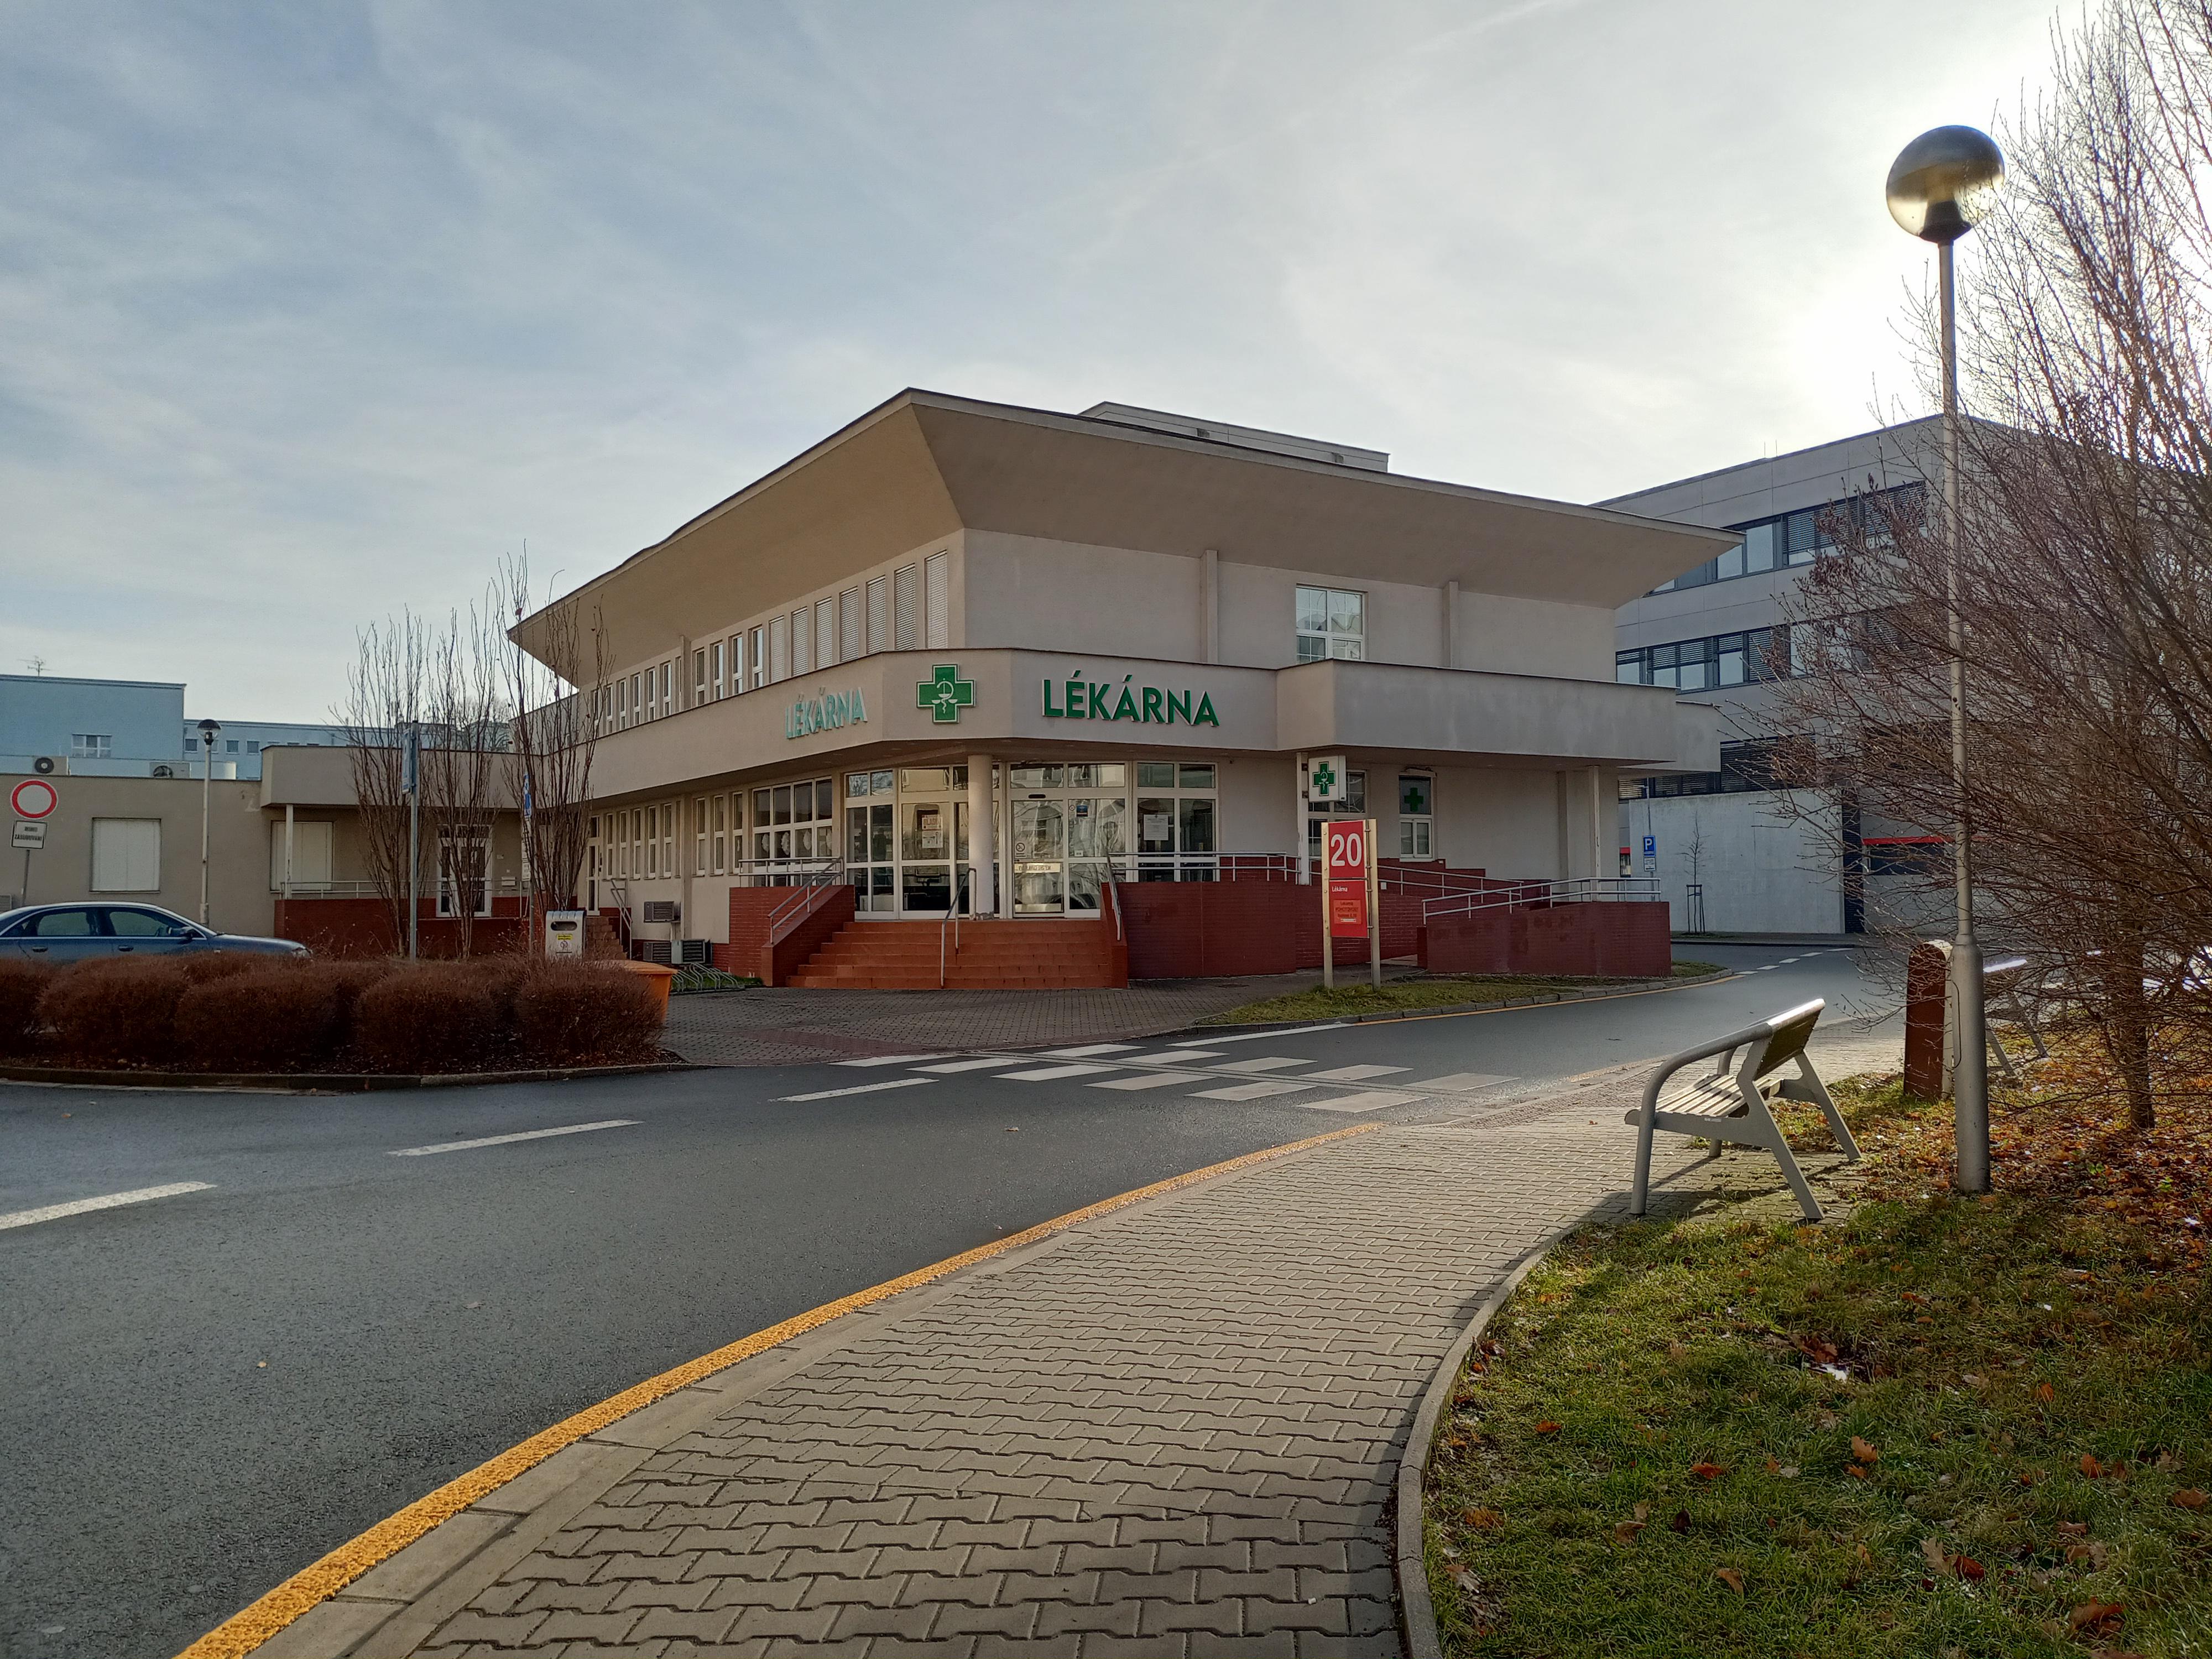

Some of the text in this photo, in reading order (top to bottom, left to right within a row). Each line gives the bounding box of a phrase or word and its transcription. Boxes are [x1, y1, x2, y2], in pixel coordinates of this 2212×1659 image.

[785, 686, 868, 739] LÉKÁRNA
[1042, 670, 1220, 727] LÉKÁRNA
[1331, 833, 1361, 867] 20
[1645, 838, 1653, 851] P
